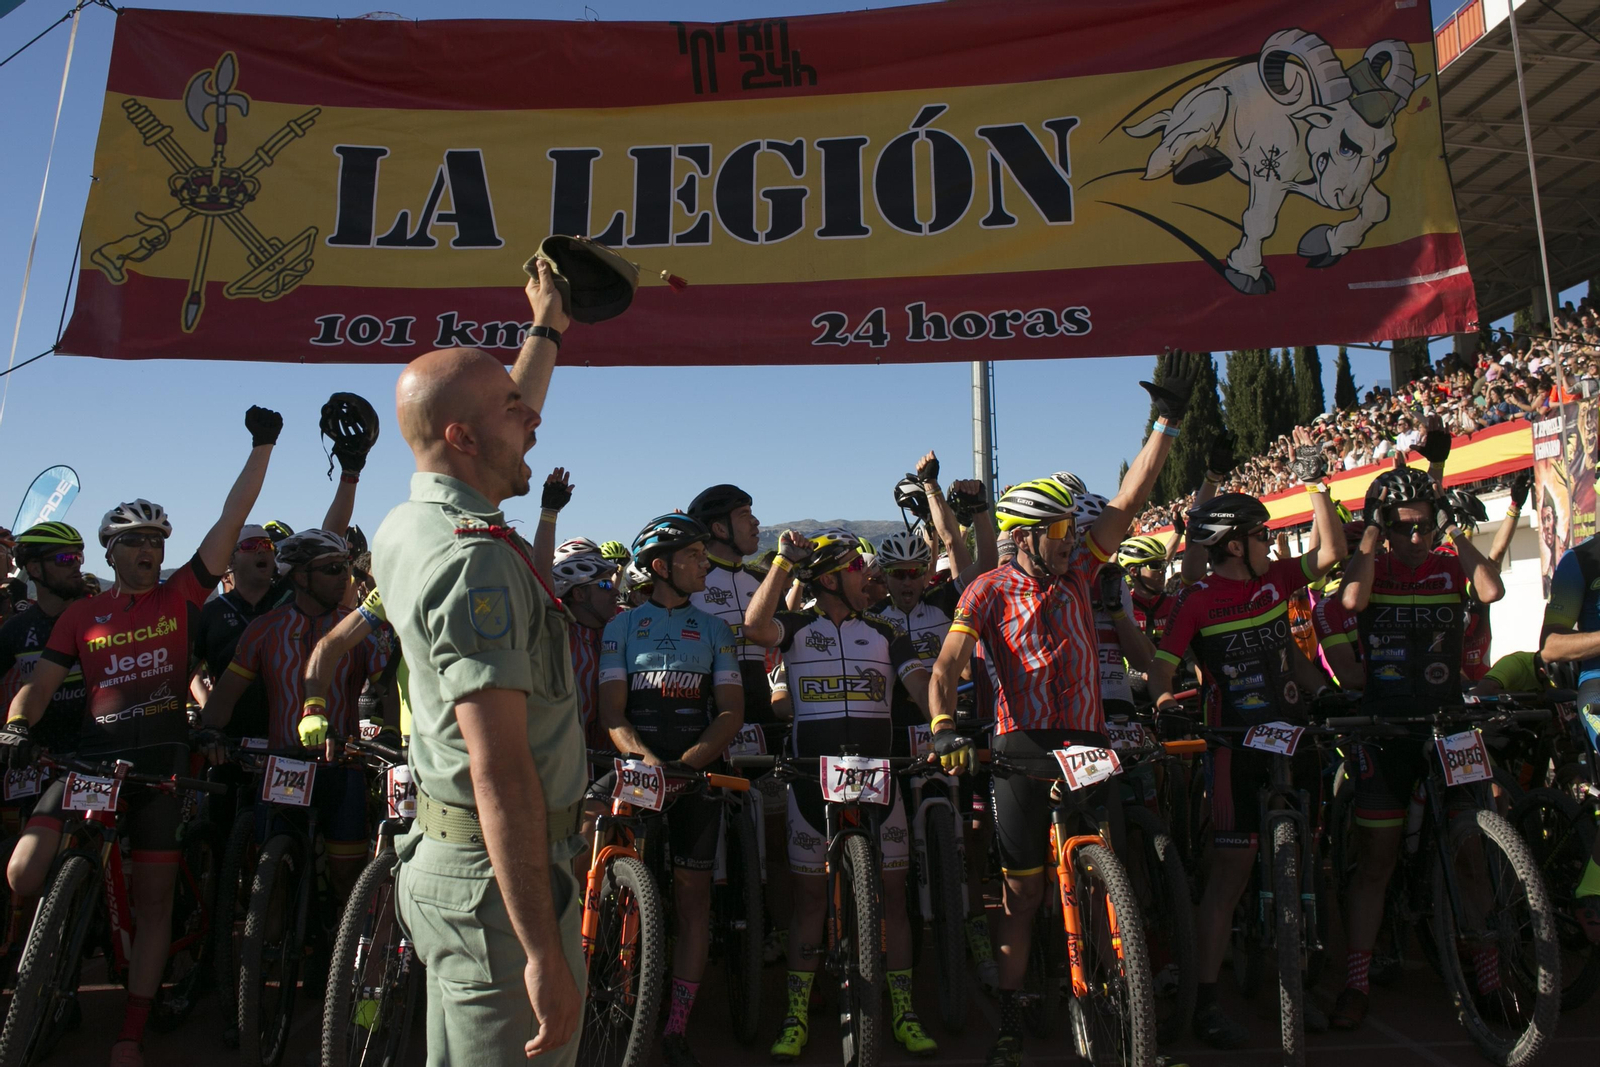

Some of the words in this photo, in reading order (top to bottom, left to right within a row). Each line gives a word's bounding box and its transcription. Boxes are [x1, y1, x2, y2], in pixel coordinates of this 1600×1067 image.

[326, 143, 505, 249] LA
[545, 103, 1081, 249] LEGIÓN
[309, 313, 416, 346] 101
[433, 311, 534, 349] km
[811, 307, 890, 348] 24
[905, 301, 1092, 342] horas
[1017, 498, 1034, 506] GIRO
[1375, 606, 1454, 623] ZERO
[1222, 620, 1287, 652] ZERO
[104, 647, 168, 676] Jeep
[99, 673, 137, 689] HUERTAS
[141, 664, 174, 679] CENTER
[631, 671, 703, 691] MAKINON
[661, 681, 701, 699] bikes
[95, 700, 178, 725] ROCABIKE
[1255, 725, 1294, 742] 9452
[1066, 748, 1109, 770] 7708
[1447, 746, 1483, 769] 8056
[72, 779, 113, 794] 8452
[274, 769, 306, 789] 7124
[623, 770, 660, 792] 9804
[1063, 883, 1078, 906] 32
[1068, 941, 1080, 968] FOX
